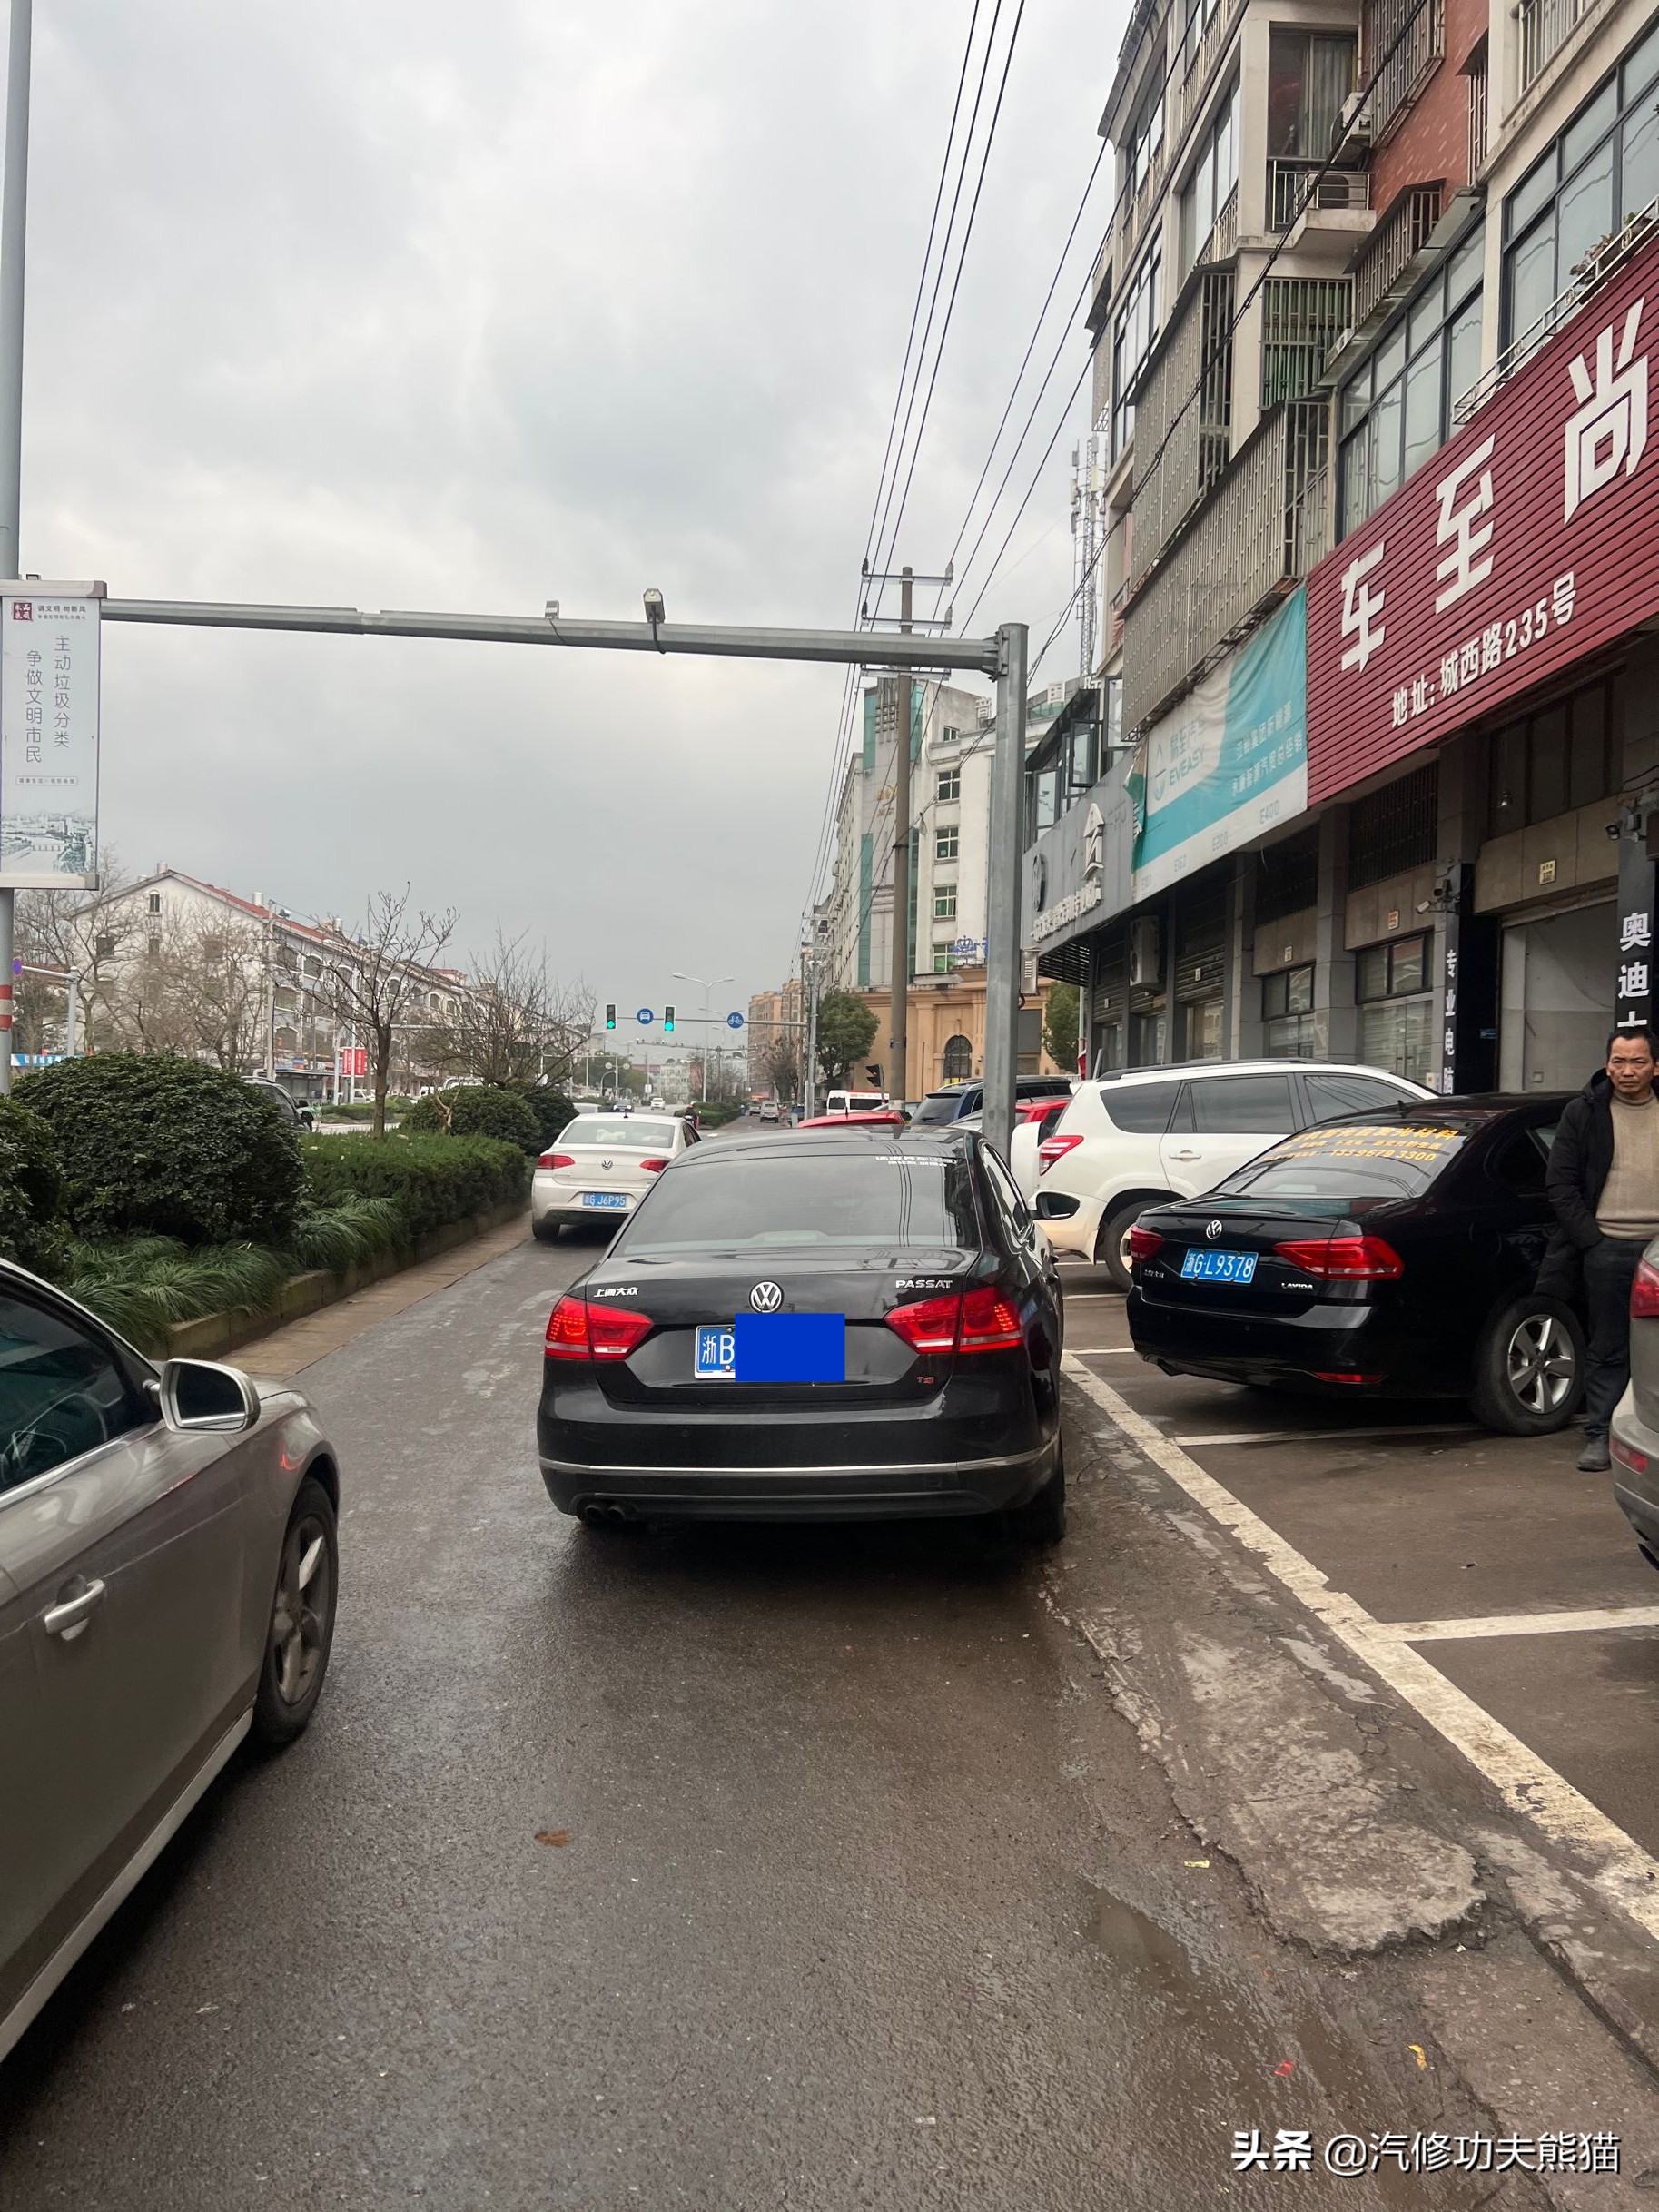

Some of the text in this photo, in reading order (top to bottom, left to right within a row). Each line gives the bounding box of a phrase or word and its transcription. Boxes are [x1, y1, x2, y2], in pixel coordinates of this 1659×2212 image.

[26, 651, 43, 763] 争做文明市民
[54, 636, 71, 748] 主动垃圾分类
[593, 1286, 639, 1298] 上海大众
[895, 1279, 953, 1289] PASSAT
